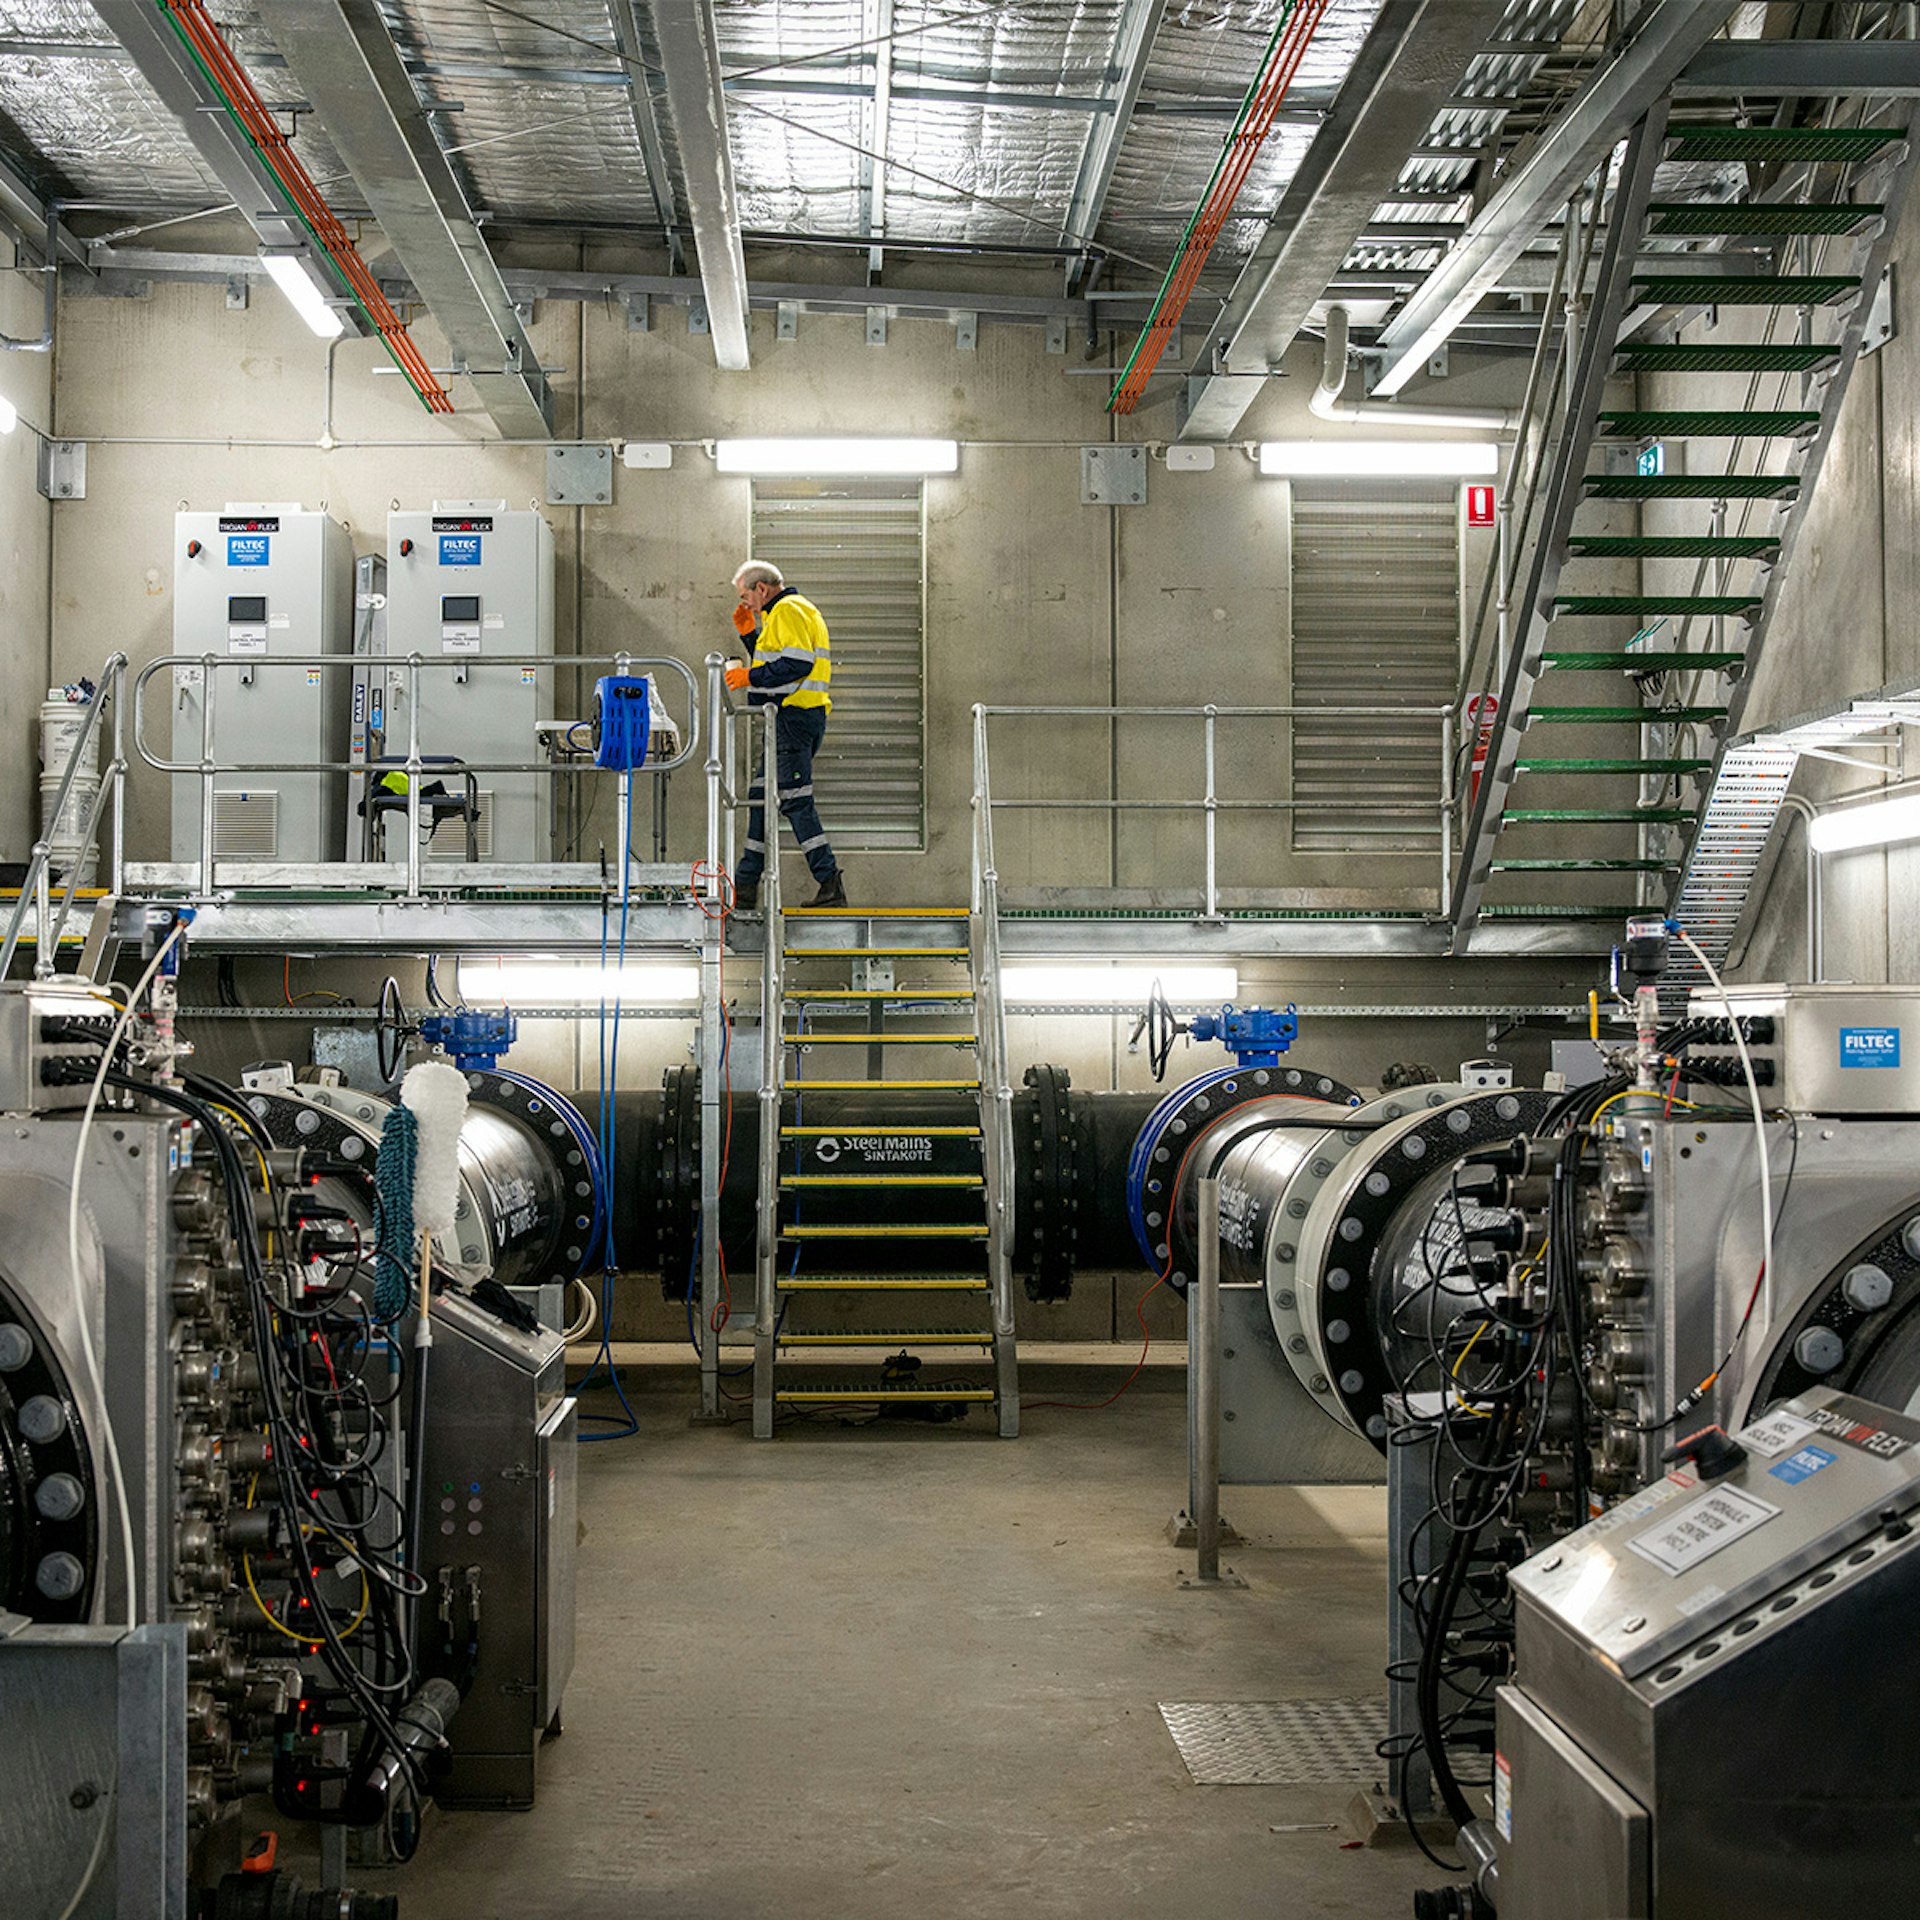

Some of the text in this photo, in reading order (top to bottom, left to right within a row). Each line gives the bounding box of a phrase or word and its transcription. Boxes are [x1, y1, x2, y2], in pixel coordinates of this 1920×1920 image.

[231, 540, 265, 550] FILTEC
[443, 540, 477, 549] FILTEC
[355, 684, 364, 723] BAILEY
[1845, 1035, 1895, 1048] FILTEC
[844, 1137, 932, 1150] Steel Mains
[864, 1150, 932, 1161] SINTAKOTE
[1693, 1511, 1727, 1531] SYSTEM
